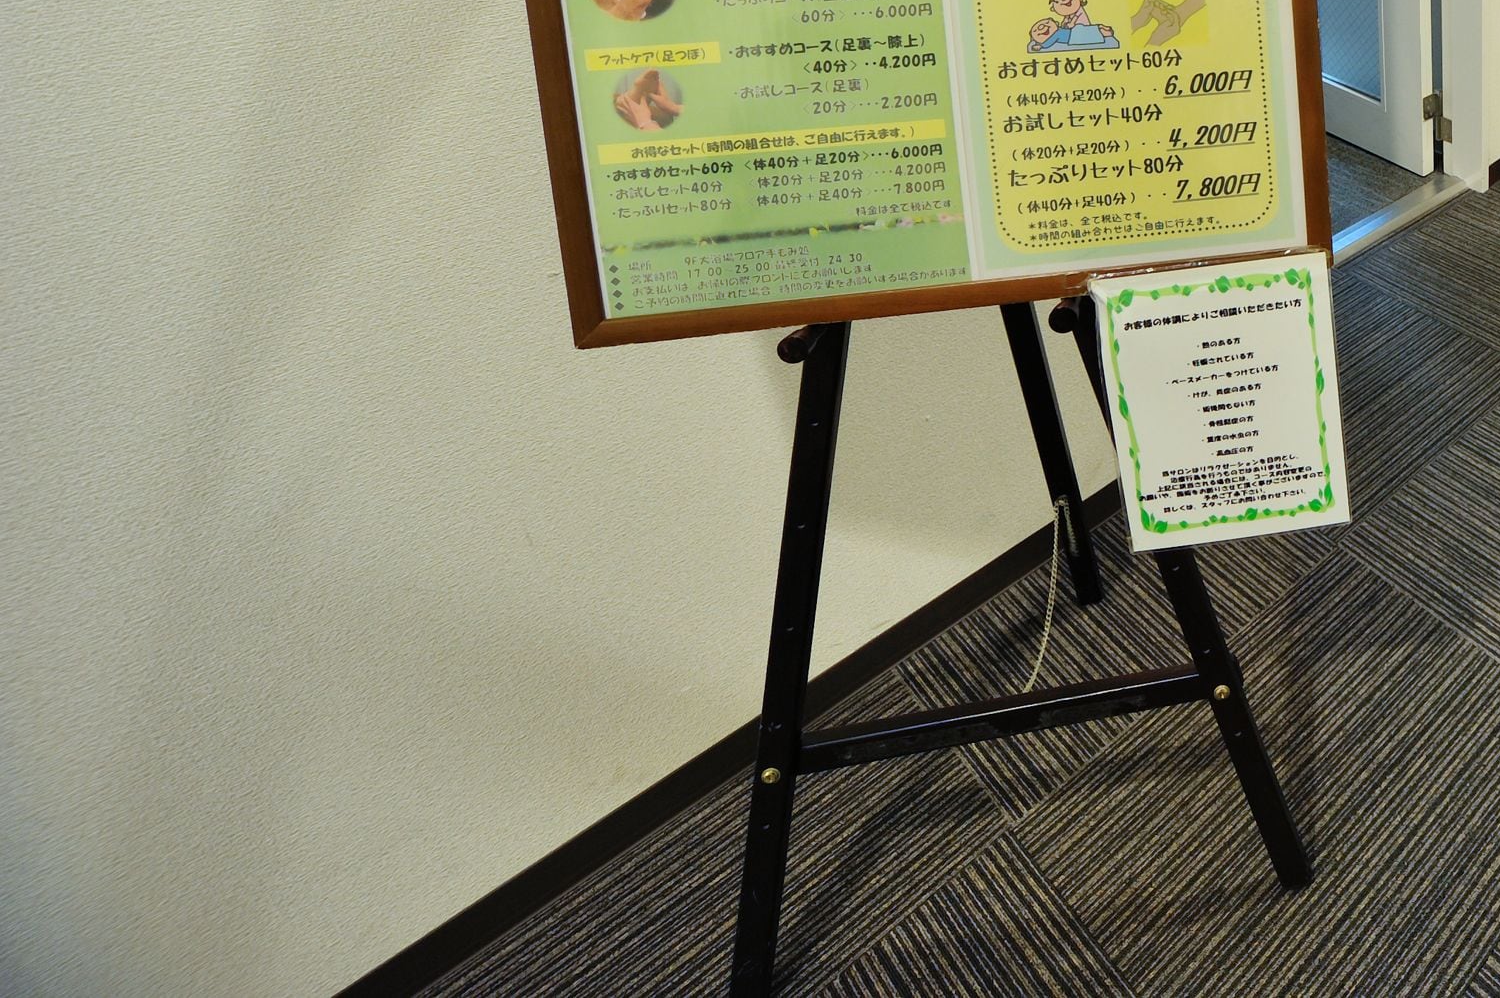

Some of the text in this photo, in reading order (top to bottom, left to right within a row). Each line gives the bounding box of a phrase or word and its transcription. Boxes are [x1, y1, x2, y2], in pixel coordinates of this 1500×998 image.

[998, 49, 1183, 80] おすすめセット60分
[1003, 103, 1164, 135] お試しセット40分
[1008, 154, 1185, 188] たっぷりセット80分
